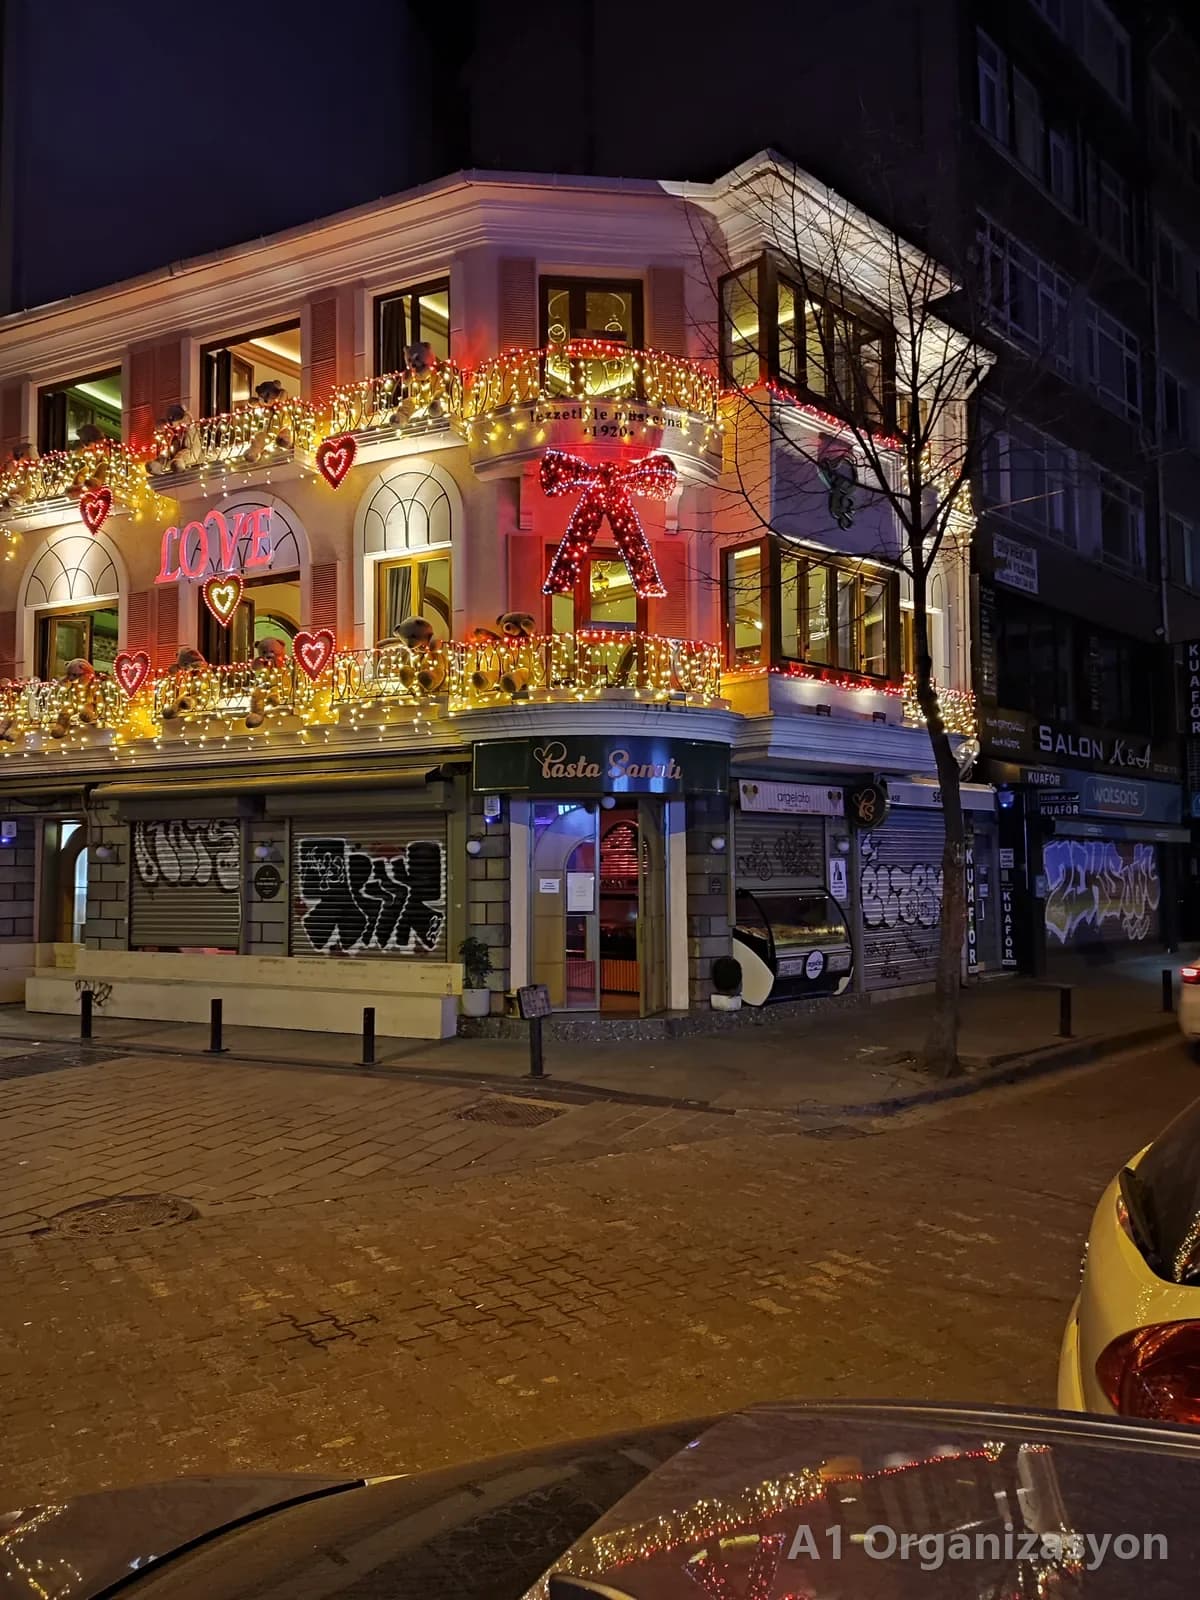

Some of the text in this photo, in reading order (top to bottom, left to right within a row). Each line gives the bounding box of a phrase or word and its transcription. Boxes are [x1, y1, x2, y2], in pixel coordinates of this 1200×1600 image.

[154, 506, 273, 585] LOVE
[533, 741, 602, 779] Pasta
[1040, 801, 1080, 817] KUAFÖR
[1002, 891, 1015, 960] KUAFÖR
